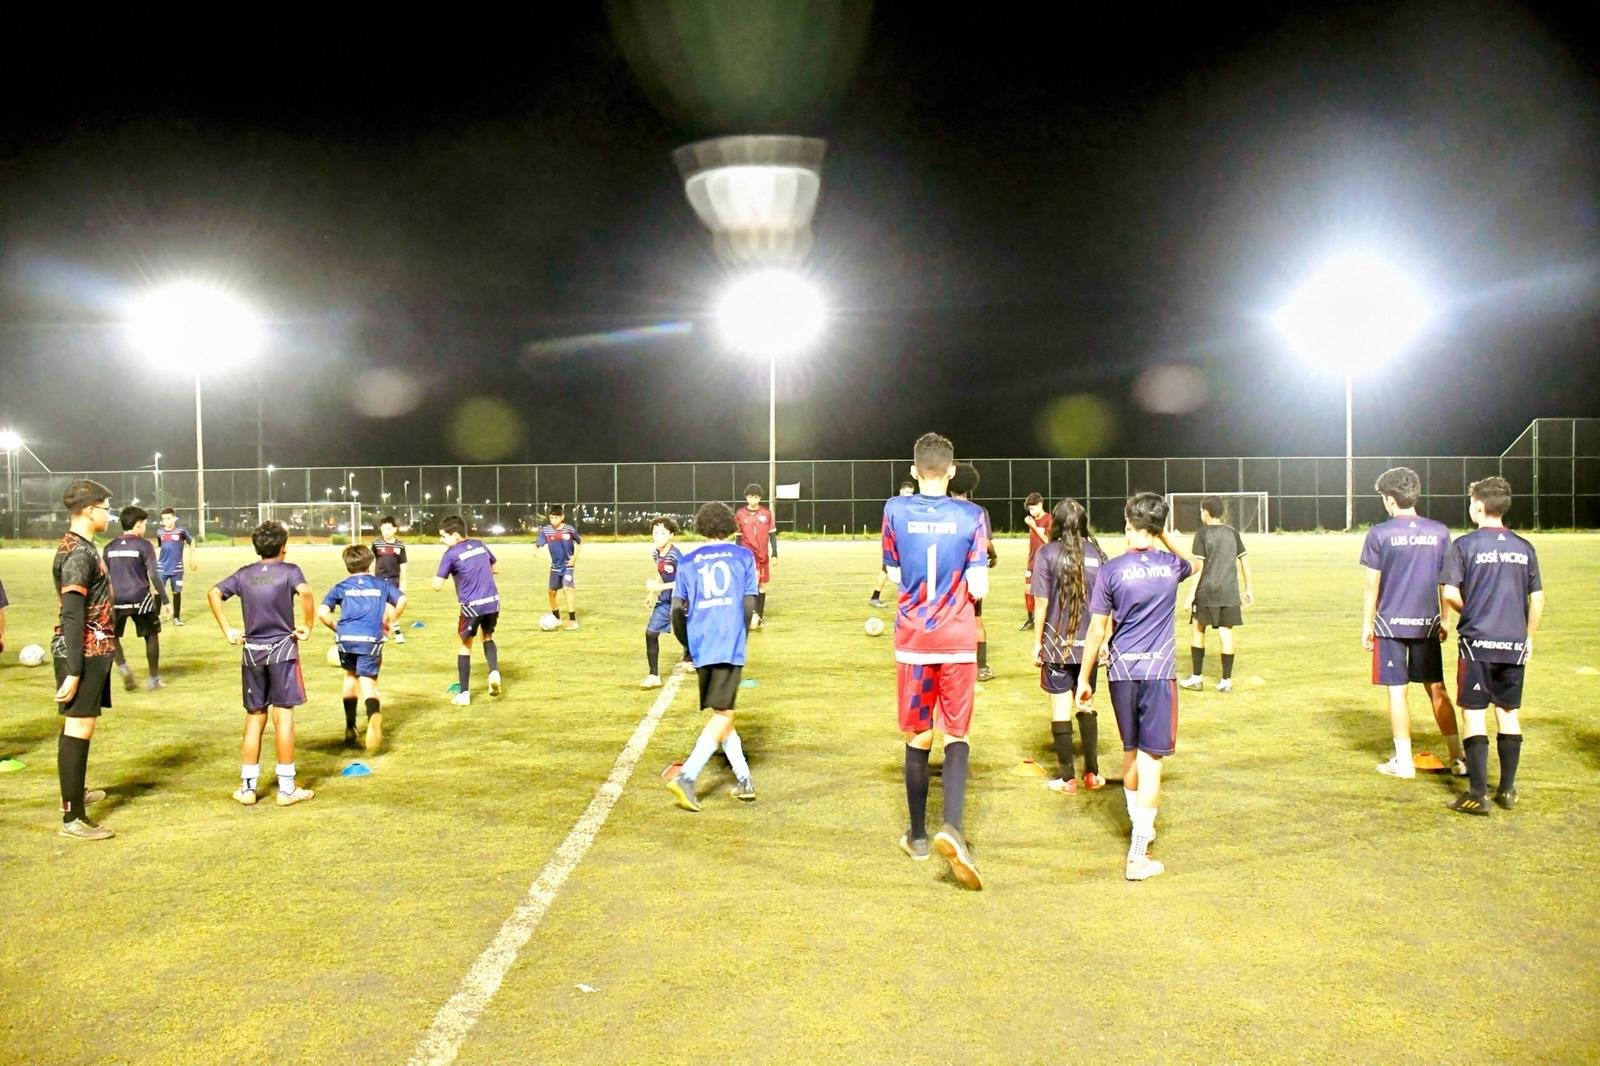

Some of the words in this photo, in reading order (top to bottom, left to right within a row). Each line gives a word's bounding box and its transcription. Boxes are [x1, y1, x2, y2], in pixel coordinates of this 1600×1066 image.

[1391, 536, 1408, 546] LUIS
[1409, 536, 1438, 546] CARLOS
[1475, 549, 1498, 564] JOSÉ
[1499, 552, 1528, 565] VICTOR
[927, 543, 937, 601] 1
[1122, 566, 1146, 580] JOÃO
[1147, 565, 1172, 577] VITOR
[698, 560, 731, 600] 10
[1472, 640, 1513, 650] APRENDIZ
